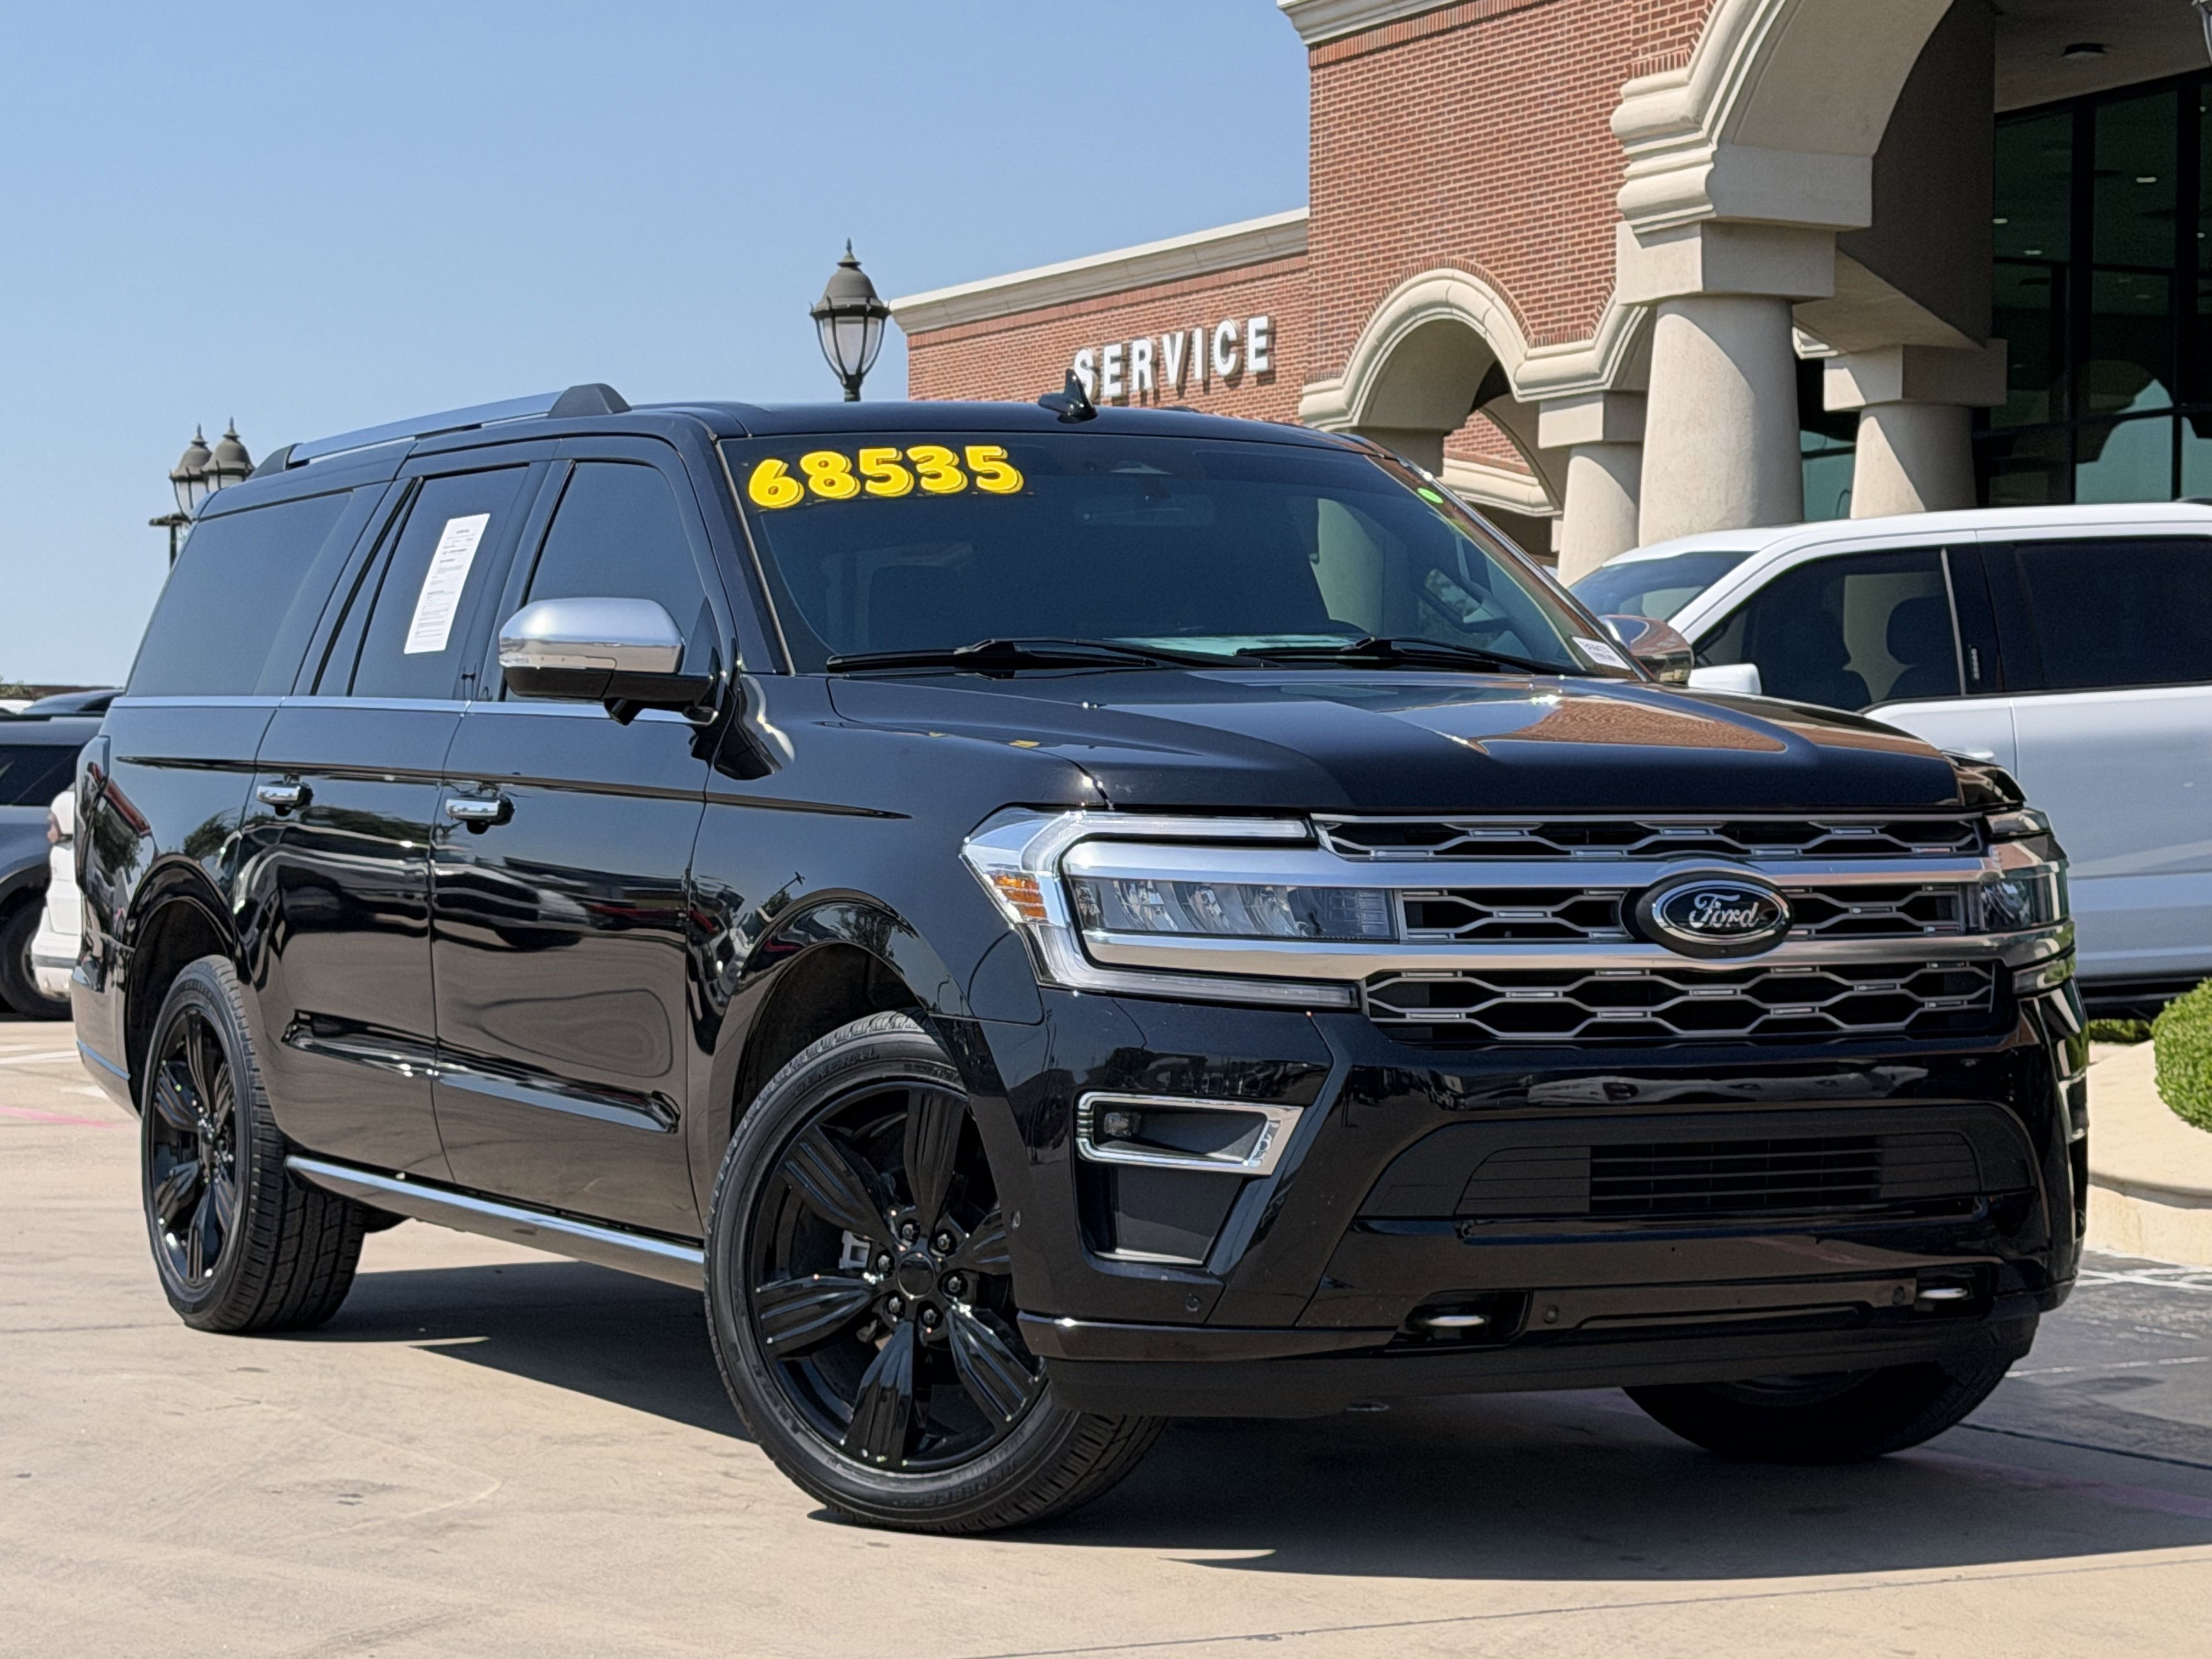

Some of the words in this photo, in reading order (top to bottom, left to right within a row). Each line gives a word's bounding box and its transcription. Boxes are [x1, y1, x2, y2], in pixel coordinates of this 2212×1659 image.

[1073, 314, 1274, 400] SERVICE
[748, 445, 1024, 509] 68535
[1689, 893, 1759, 928] Ford
